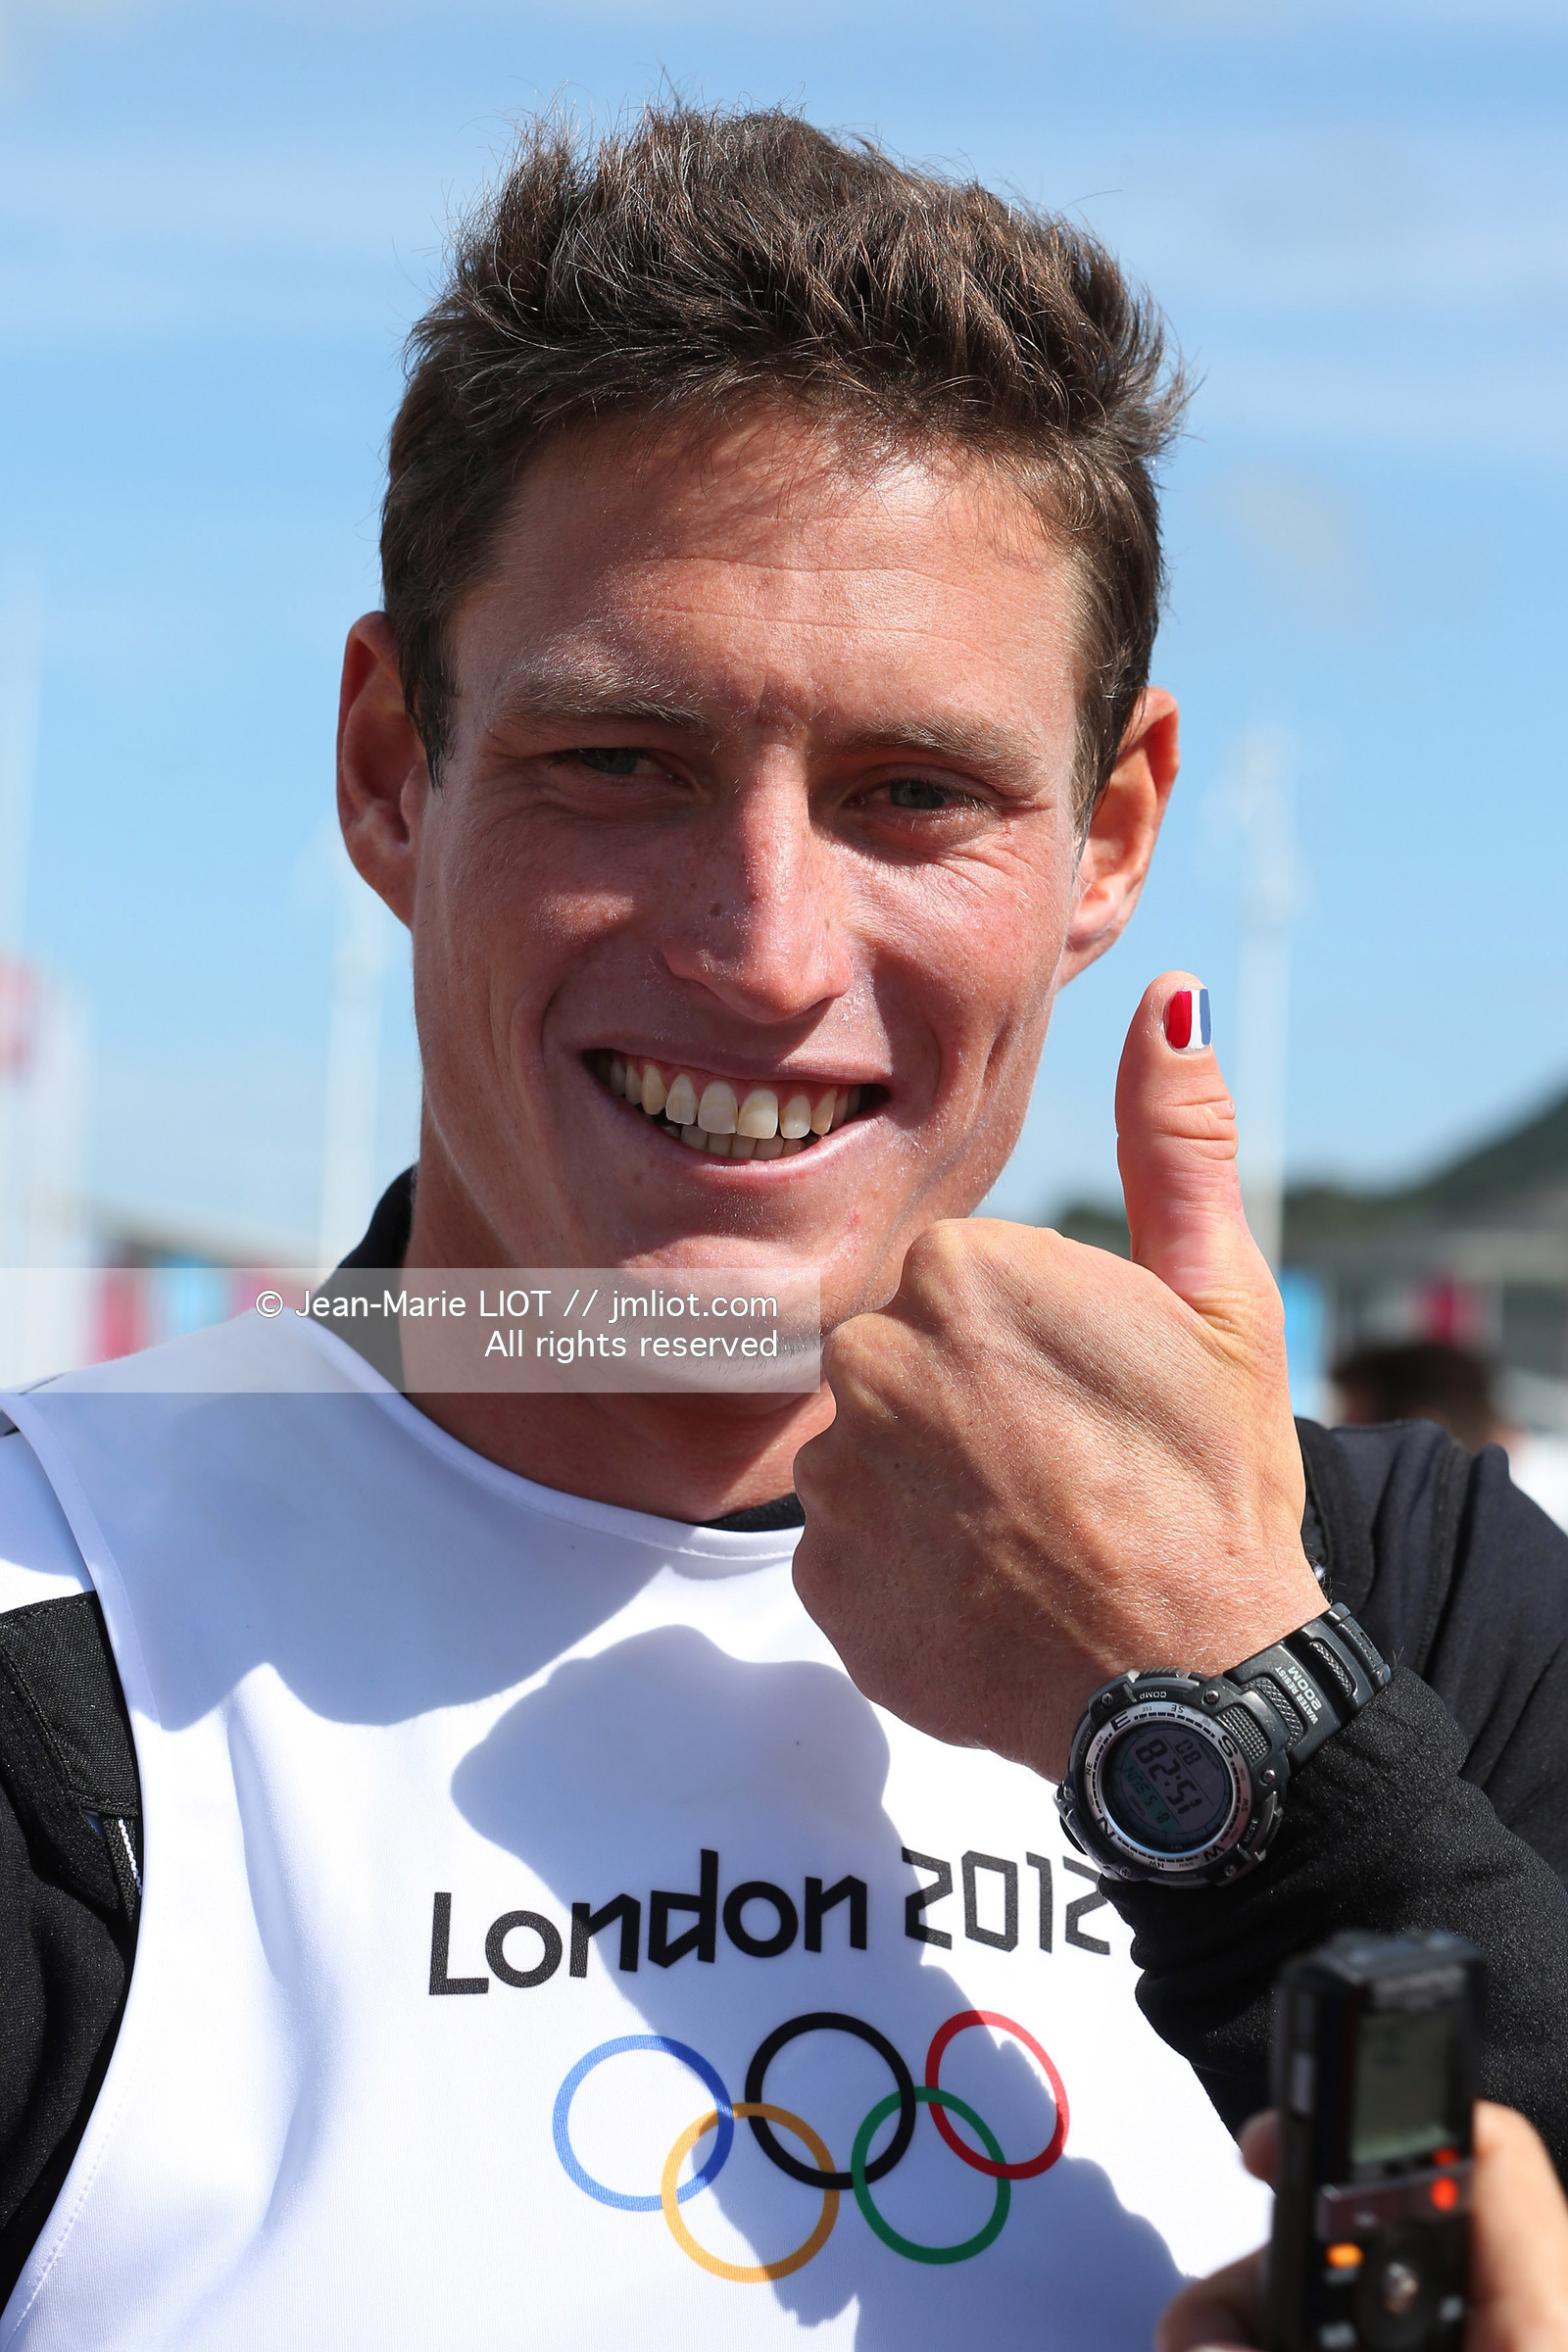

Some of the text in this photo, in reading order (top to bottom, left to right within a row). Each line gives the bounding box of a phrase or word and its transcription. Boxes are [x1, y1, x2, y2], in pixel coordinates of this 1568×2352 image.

[1139, 1690, 1167, 1700] COMP
[1274, 1666, 1319, 1725] WATER RESIST
[1287, 1666, 1322, 1711] 200M
[1109, 1710, 1131, 1732] E
[1217, 1734, 1239, 1759] S
[1135, 1738, 1203, 1815] 15:28
[1097, 1815, 1116, 1839] N
[1202, 1844, 1227, 1863] W
[428, 1846, 1111, 1995] London 2012
